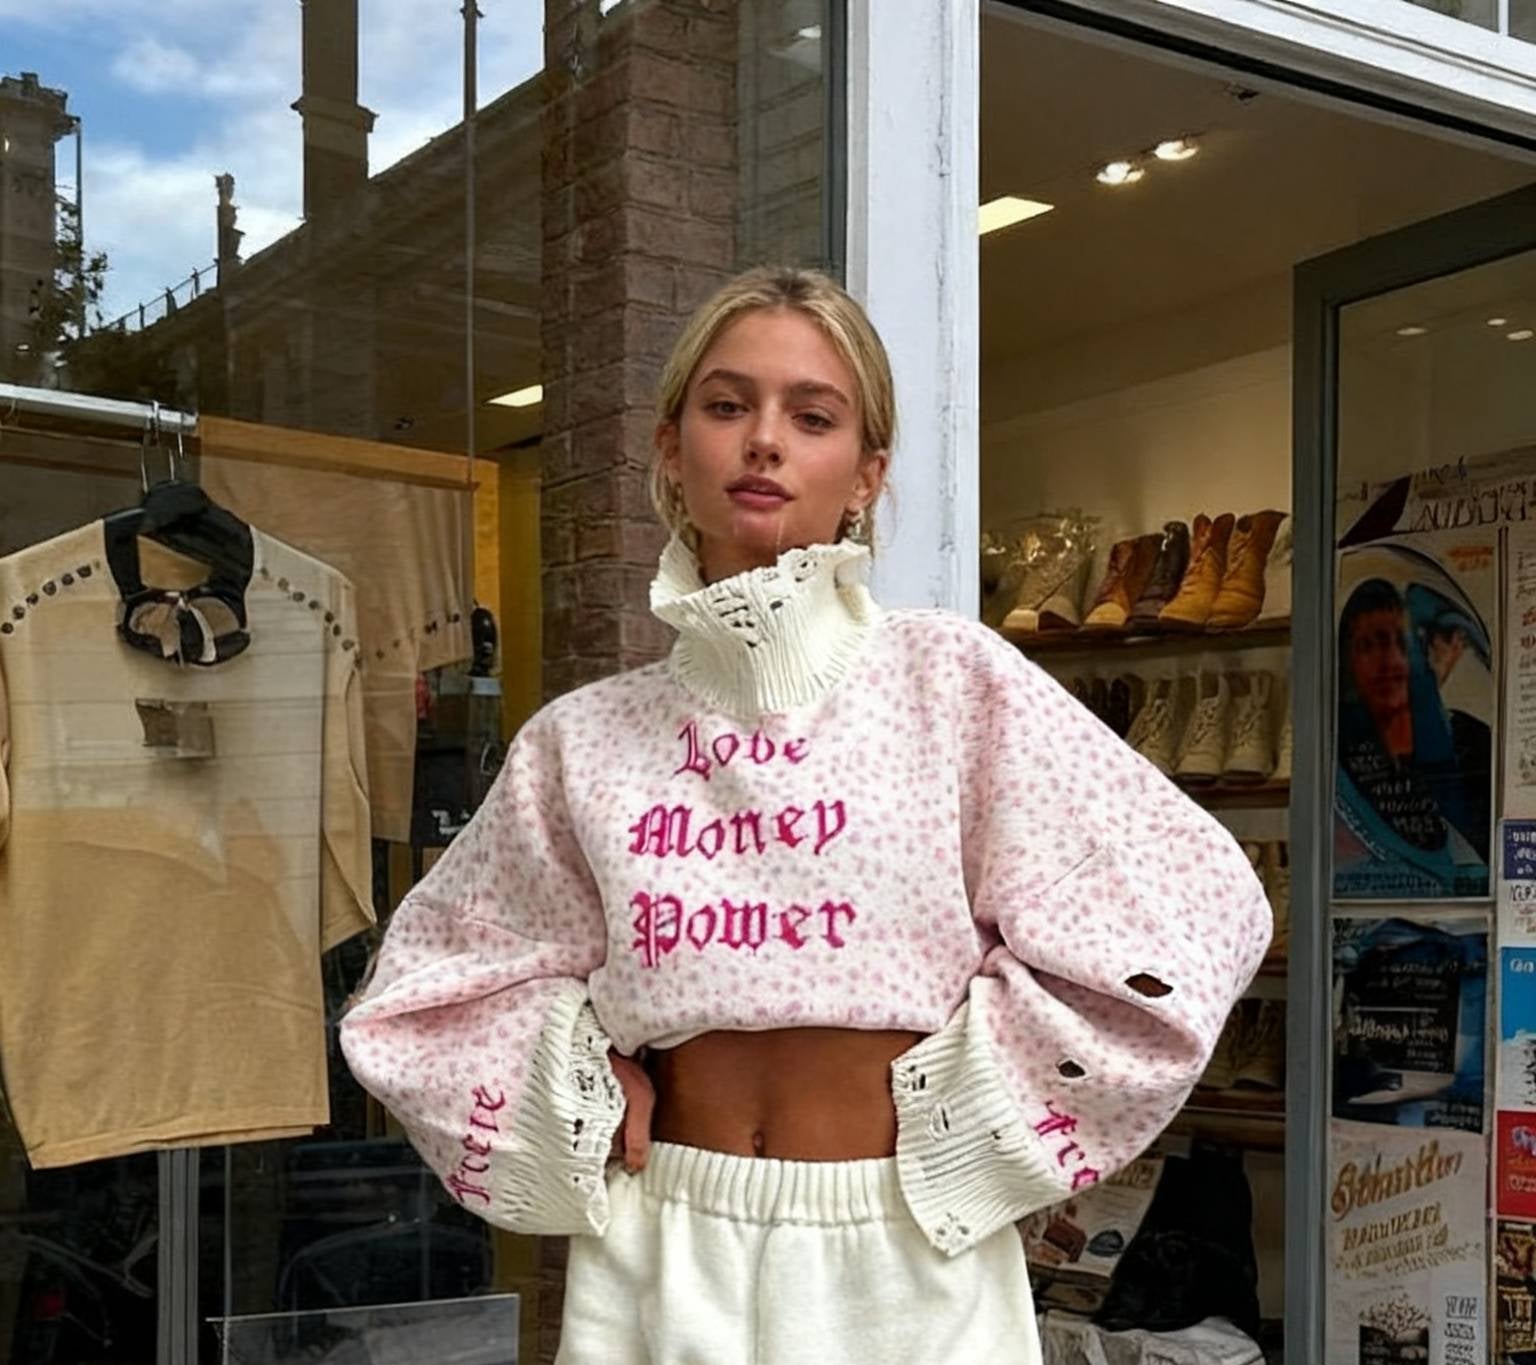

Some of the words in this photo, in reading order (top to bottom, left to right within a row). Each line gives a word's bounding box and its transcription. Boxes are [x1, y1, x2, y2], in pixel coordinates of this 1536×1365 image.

[675, 720, 809, 781] Love
[629, 799, 848, 860] Money
[630, 890, 857, 969] Power
